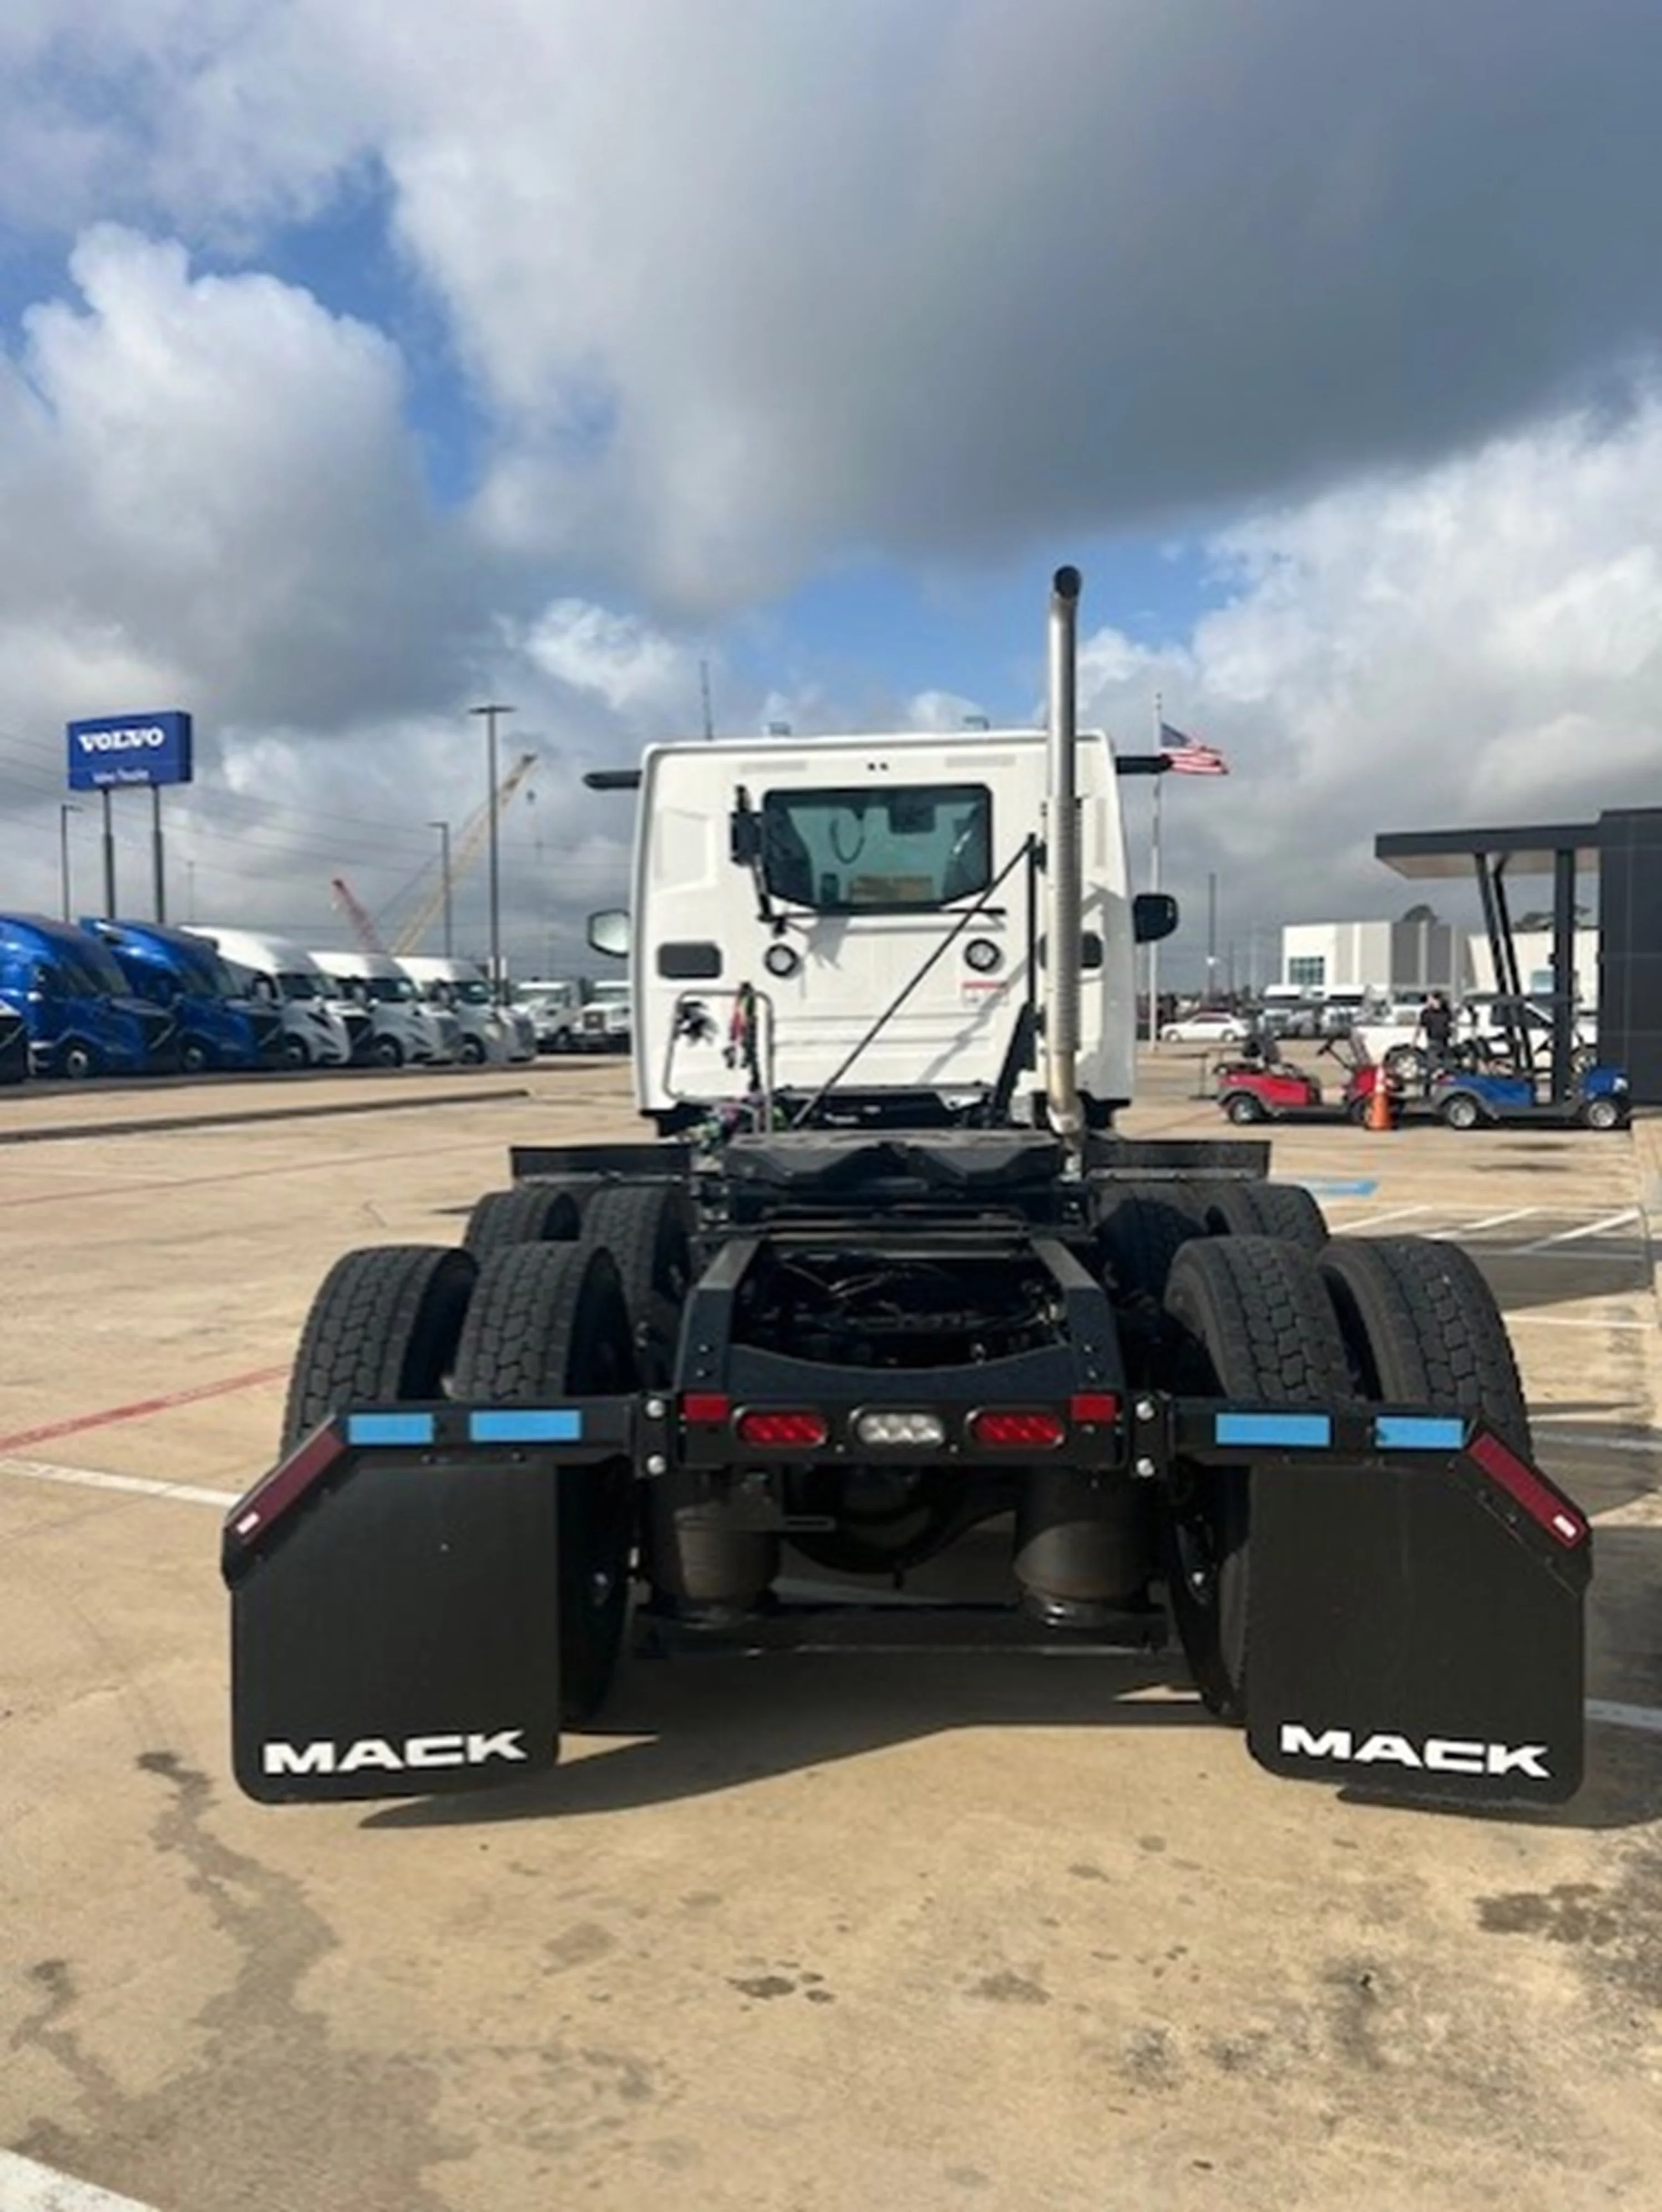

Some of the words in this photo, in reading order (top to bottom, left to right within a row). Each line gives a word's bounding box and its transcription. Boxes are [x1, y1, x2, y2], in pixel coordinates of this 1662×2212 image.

[78, 727, 164, 752] VOLVO
[264, 1729, 527, 1773] MACK
[1281, 1723, 1550, 1778] MACK
